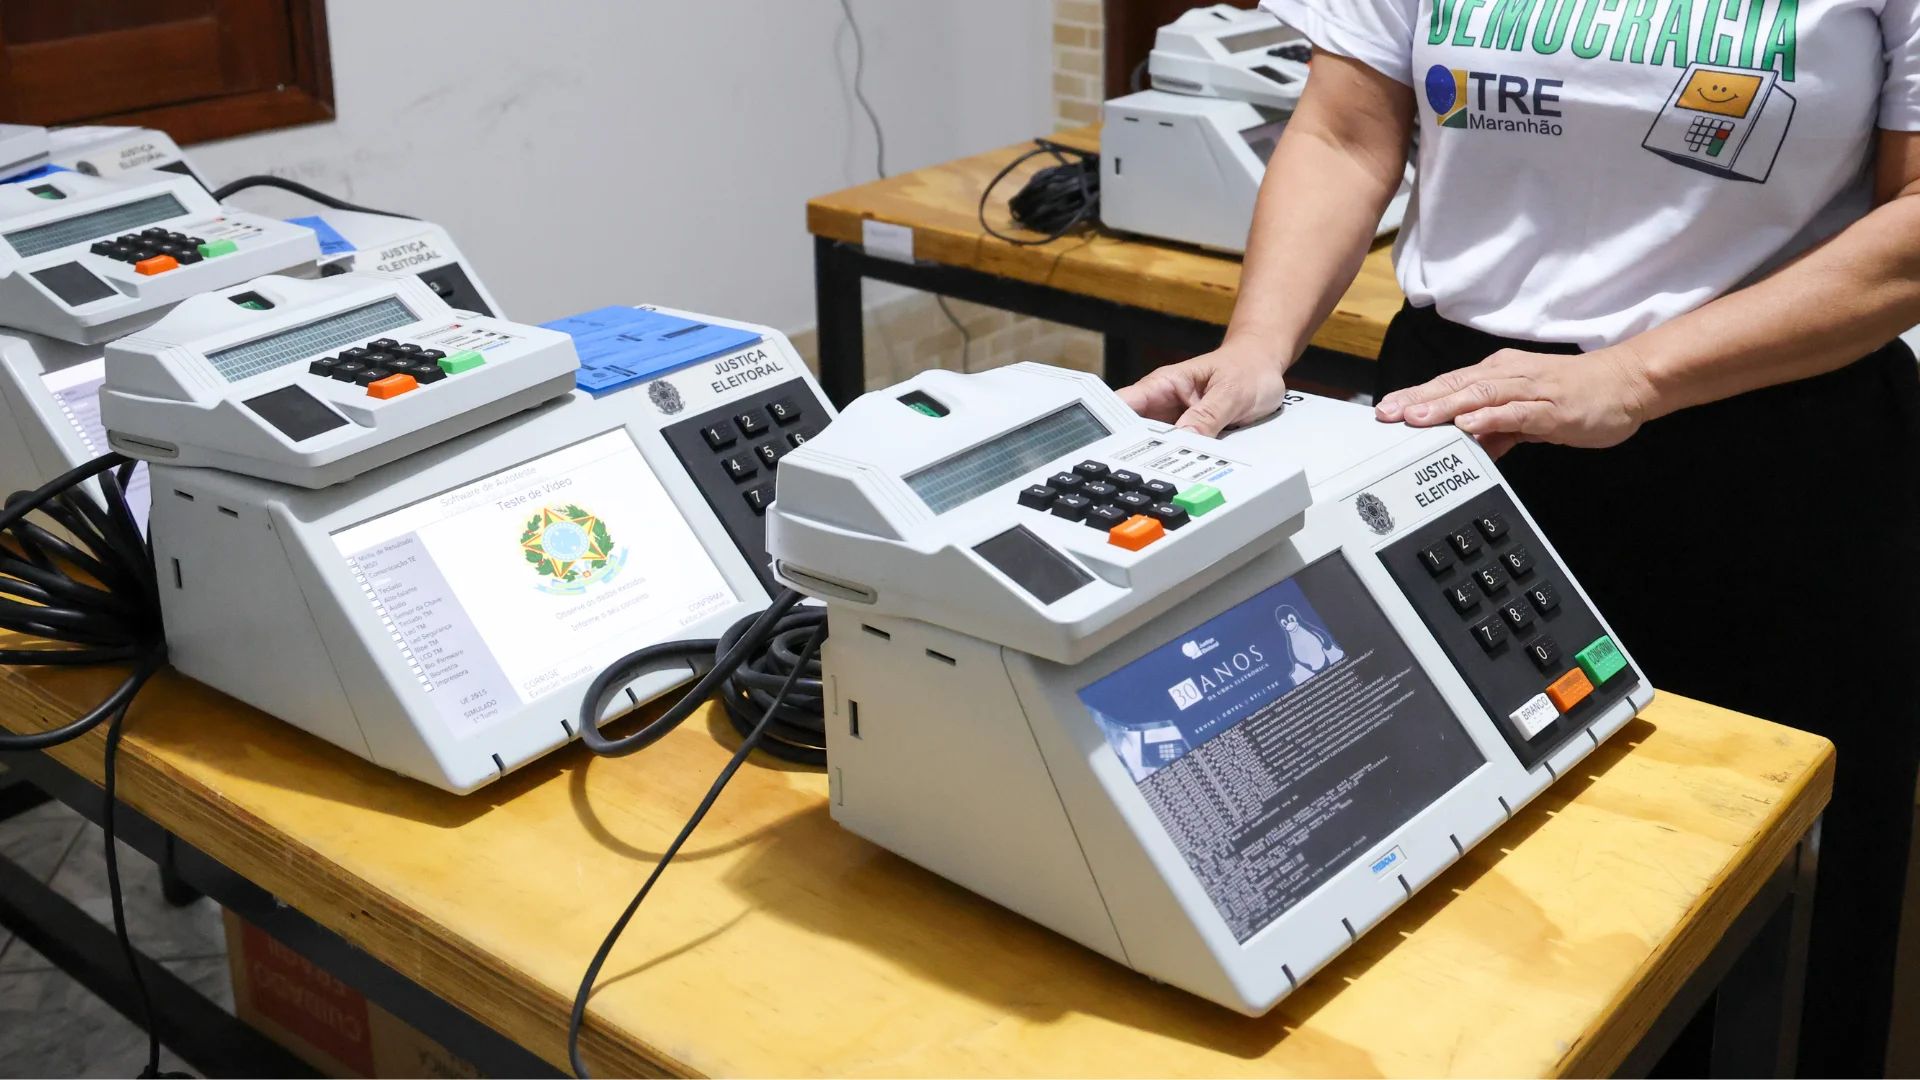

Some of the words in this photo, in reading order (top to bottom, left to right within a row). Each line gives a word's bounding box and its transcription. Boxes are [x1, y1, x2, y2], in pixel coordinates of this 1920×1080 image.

[1469, 71, 1564, 118] TRE
[1469, 113, 1563, 136] Maranhão
[380, 240, 429, 261] JUSTIÇA
[711, 362, 784, 393] ELEITORAL
[715, 349, 767, 375] JUSTIÇA
[710, 428, 720, 440] 1
[742, 415, 754, 428] 2
[774, 404, 786, 415] 3
[731, 459, 741, 471] 4
[763, 445, 774, 458] 5
[795, 433, 805, 445] 6
[1414, 453, 1463, 486] JUSTIÇA
[495, 494, 527, 511] Teste
[527, 489, 542, 500] de
[750, 490, 763, 504] 7
[1415, 468, 1480, 508] ELEITORAL
[1429, 551, 1439, 565] 1
[1456, 535, 1469, 549] 2
[1483, 519, 1496, 532] 3
[1457, 589, 1467, 602] 4
[1482, 570, 1494, 585] 5
[1509, 554, 1521, 567] 6
[1481, 626, 1493, 641] 7
[1509, 608, 1521, 622] 8
[1535, 591, 1547, 605] 9
[1536, 646, 1548, 660] 0
[1173, 682, 1198, 707] 30
[1200, 645, 1264, 693] ANOS
[463, 699, 498, 719] SIMULADO
[1521, 696, 1549, 721] BRANCO
